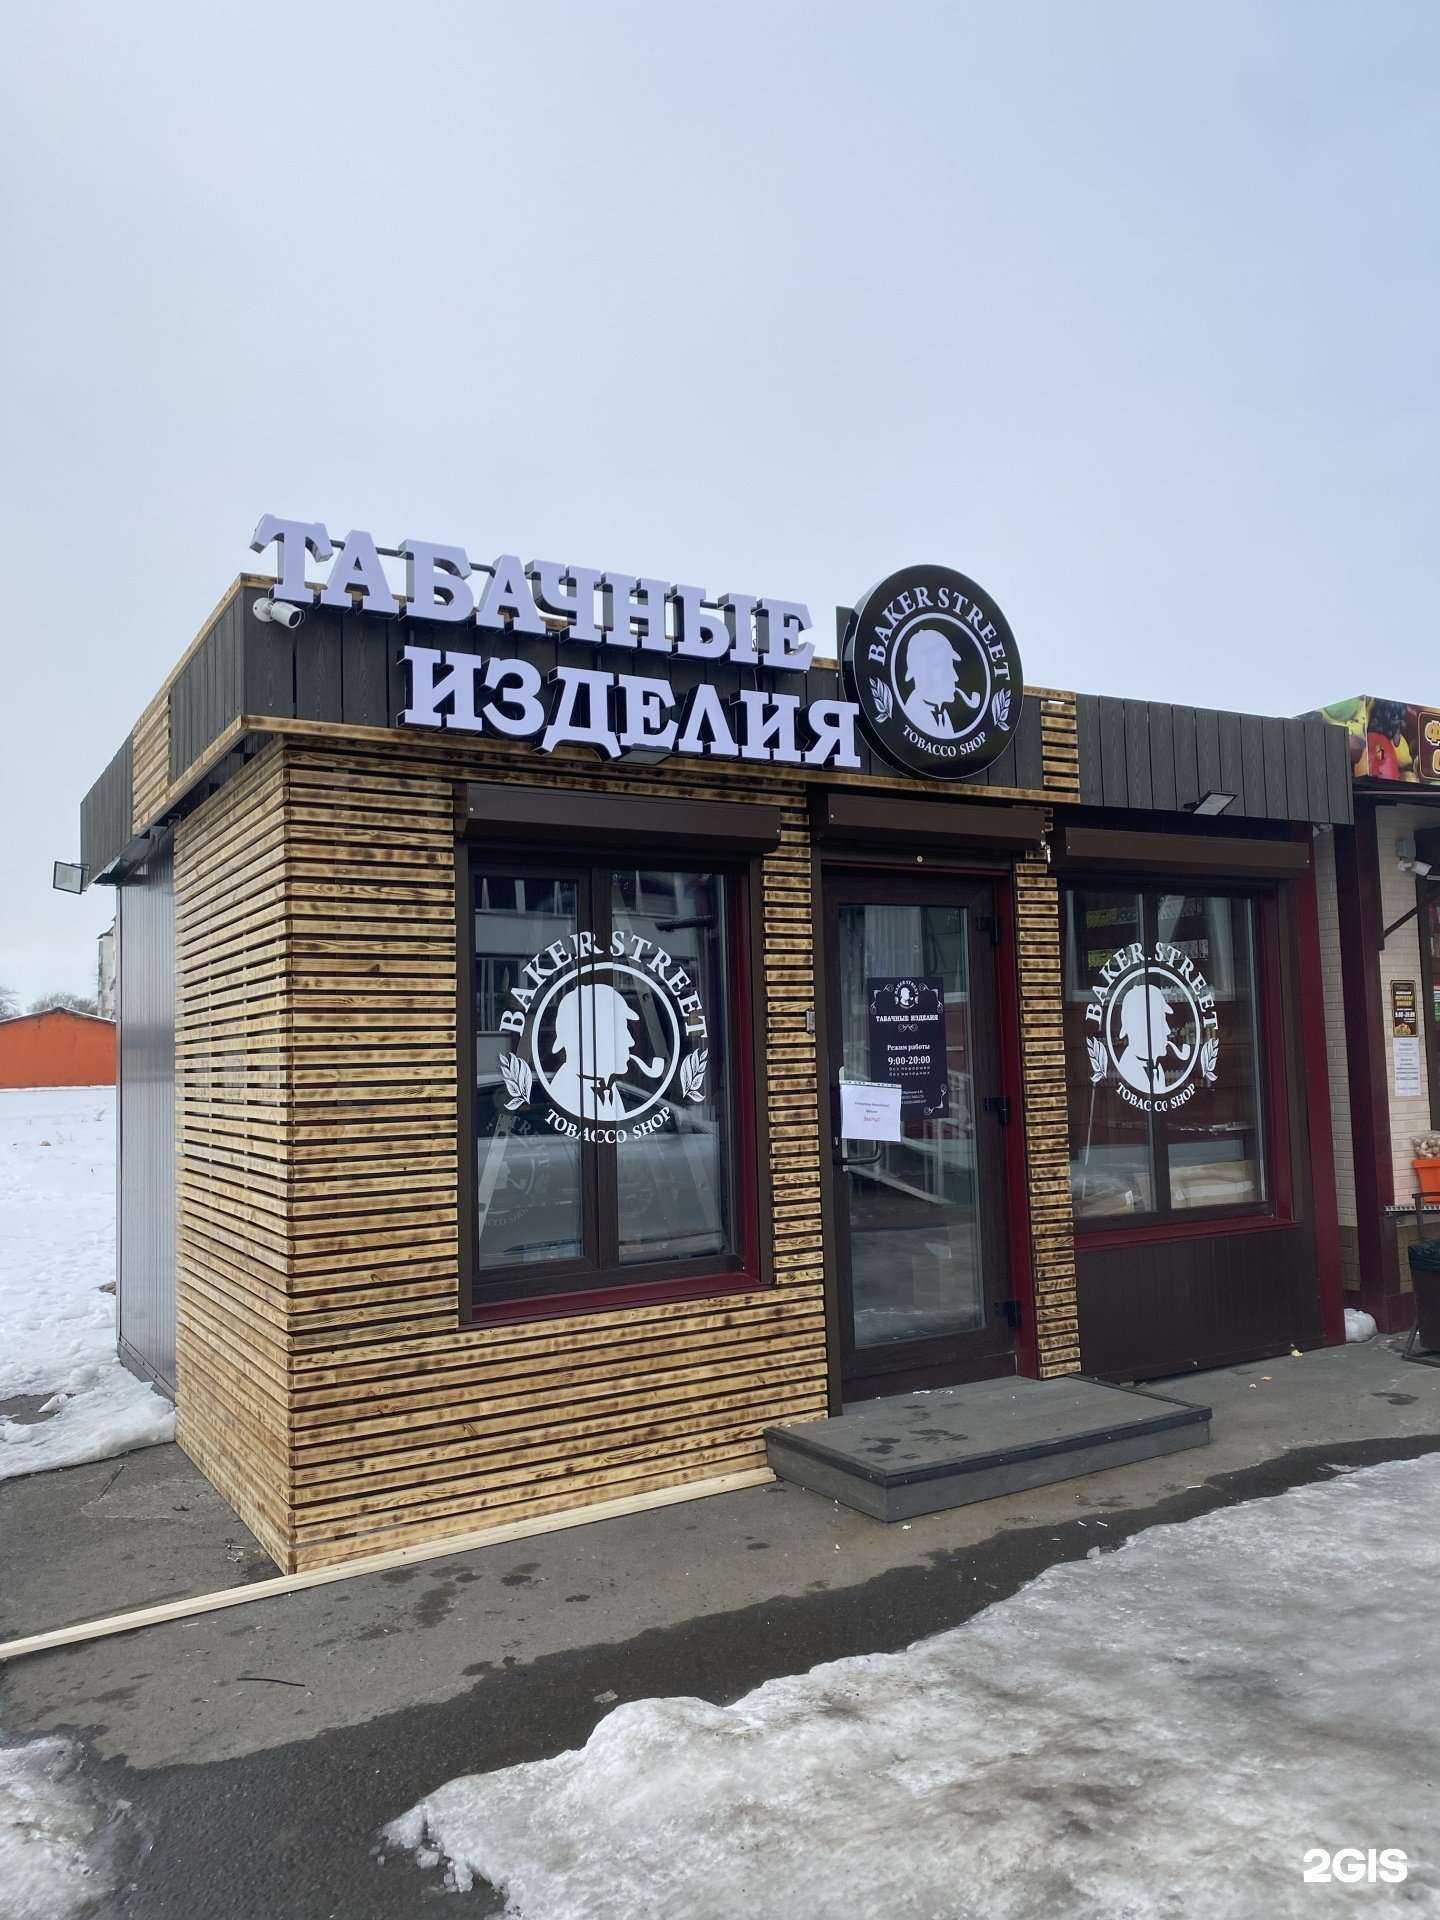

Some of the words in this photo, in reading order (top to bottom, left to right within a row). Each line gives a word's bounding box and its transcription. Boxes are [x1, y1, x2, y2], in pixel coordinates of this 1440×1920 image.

[249, 513, 815, 671] ТАБАЧНЫЕ
[868, 586, 934, 667] BAKER
[937, 586, 1011, 681] STREET
[400, 646, 861, 768] ИЗДЕЛИЯ
[902, 724, 957, 758] TOBACCO
[959, 731, 987, 757] SHOP
[499, 931, 604, 1037] BAKER
[609, 930, 709, 1038] STREET
[1085, 942, 1146, 1025] BAKER
[1155, 942, 1219, 1031] STREET
[887, 1055, 931, 1065] 9:00-20:00
[1171, 1083, 1198, 1109] SHOP
[544, 1109, 627, 1144] TOBACCO
[632, 1106, 671, 1140] SHOP
